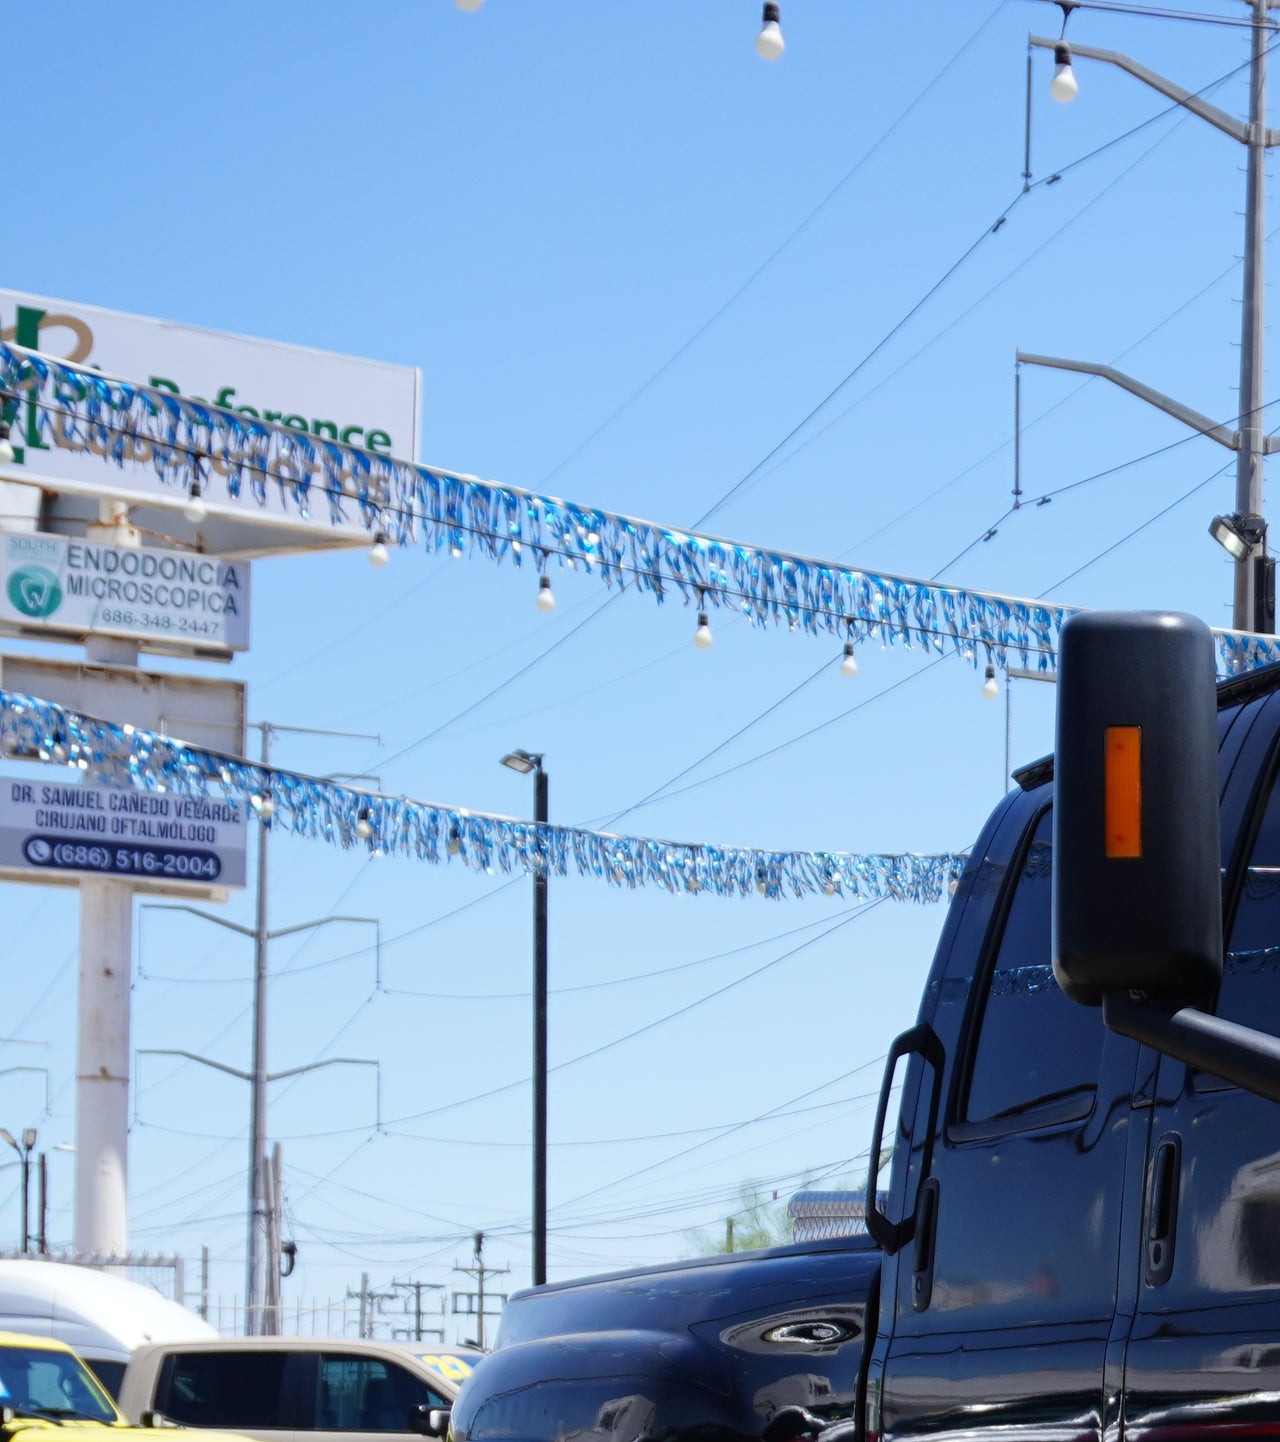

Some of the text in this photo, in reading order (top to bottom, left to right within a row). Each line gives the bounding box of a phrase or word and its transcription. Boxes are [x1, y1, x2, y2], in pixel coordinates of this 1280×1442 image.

[66, 544, 240, 589] ENDODONCIA
[66, 574, 239, 616] MICROSCOPICA
[102, 608, 220, 635] 686-348-2447
[11, 783, 241, 823] DR. SAMUEL CAÑEDO VELARDE
[35, 809, 216, 843] CIRUJANO OFTALMÓLOGO
[53, 842, 217, 877] (686) 516-2004
